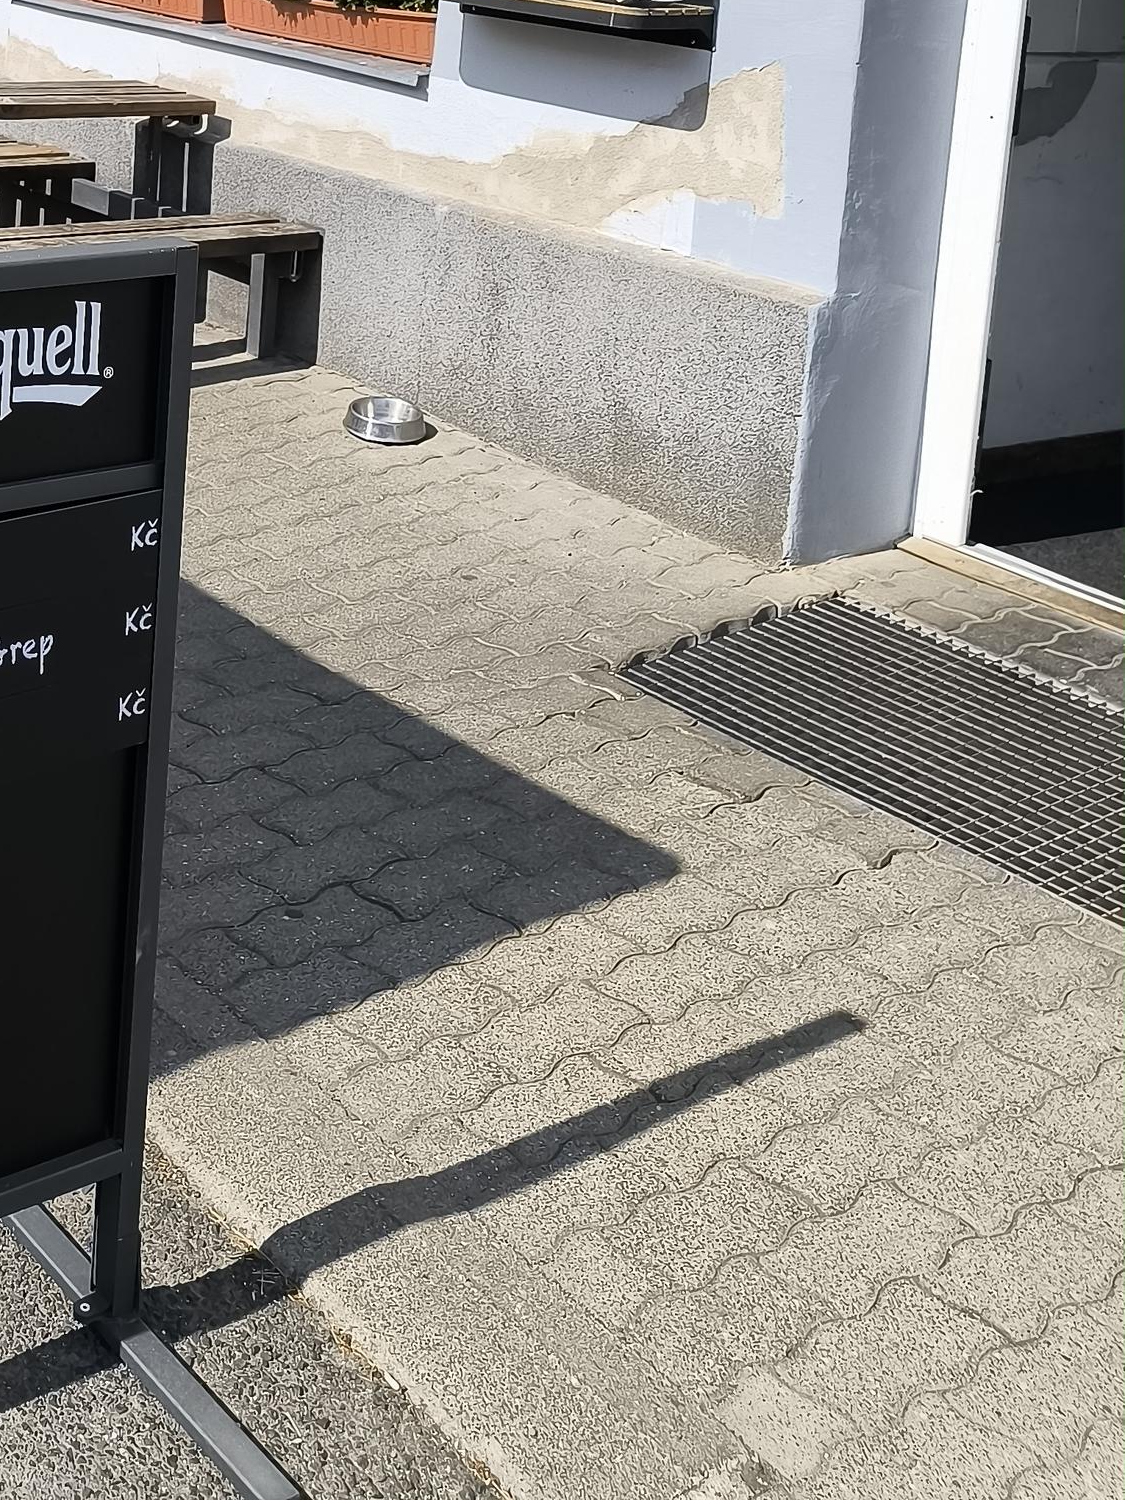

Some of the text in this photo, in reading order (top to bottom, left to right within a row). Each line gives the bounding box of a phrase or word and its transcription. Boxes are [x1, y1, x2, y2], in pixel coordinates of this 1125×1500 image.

[131, 518, 160, 552] Kč
[125, 602, 154, 636] Kč
[118, 687, 147, 722] Kč
